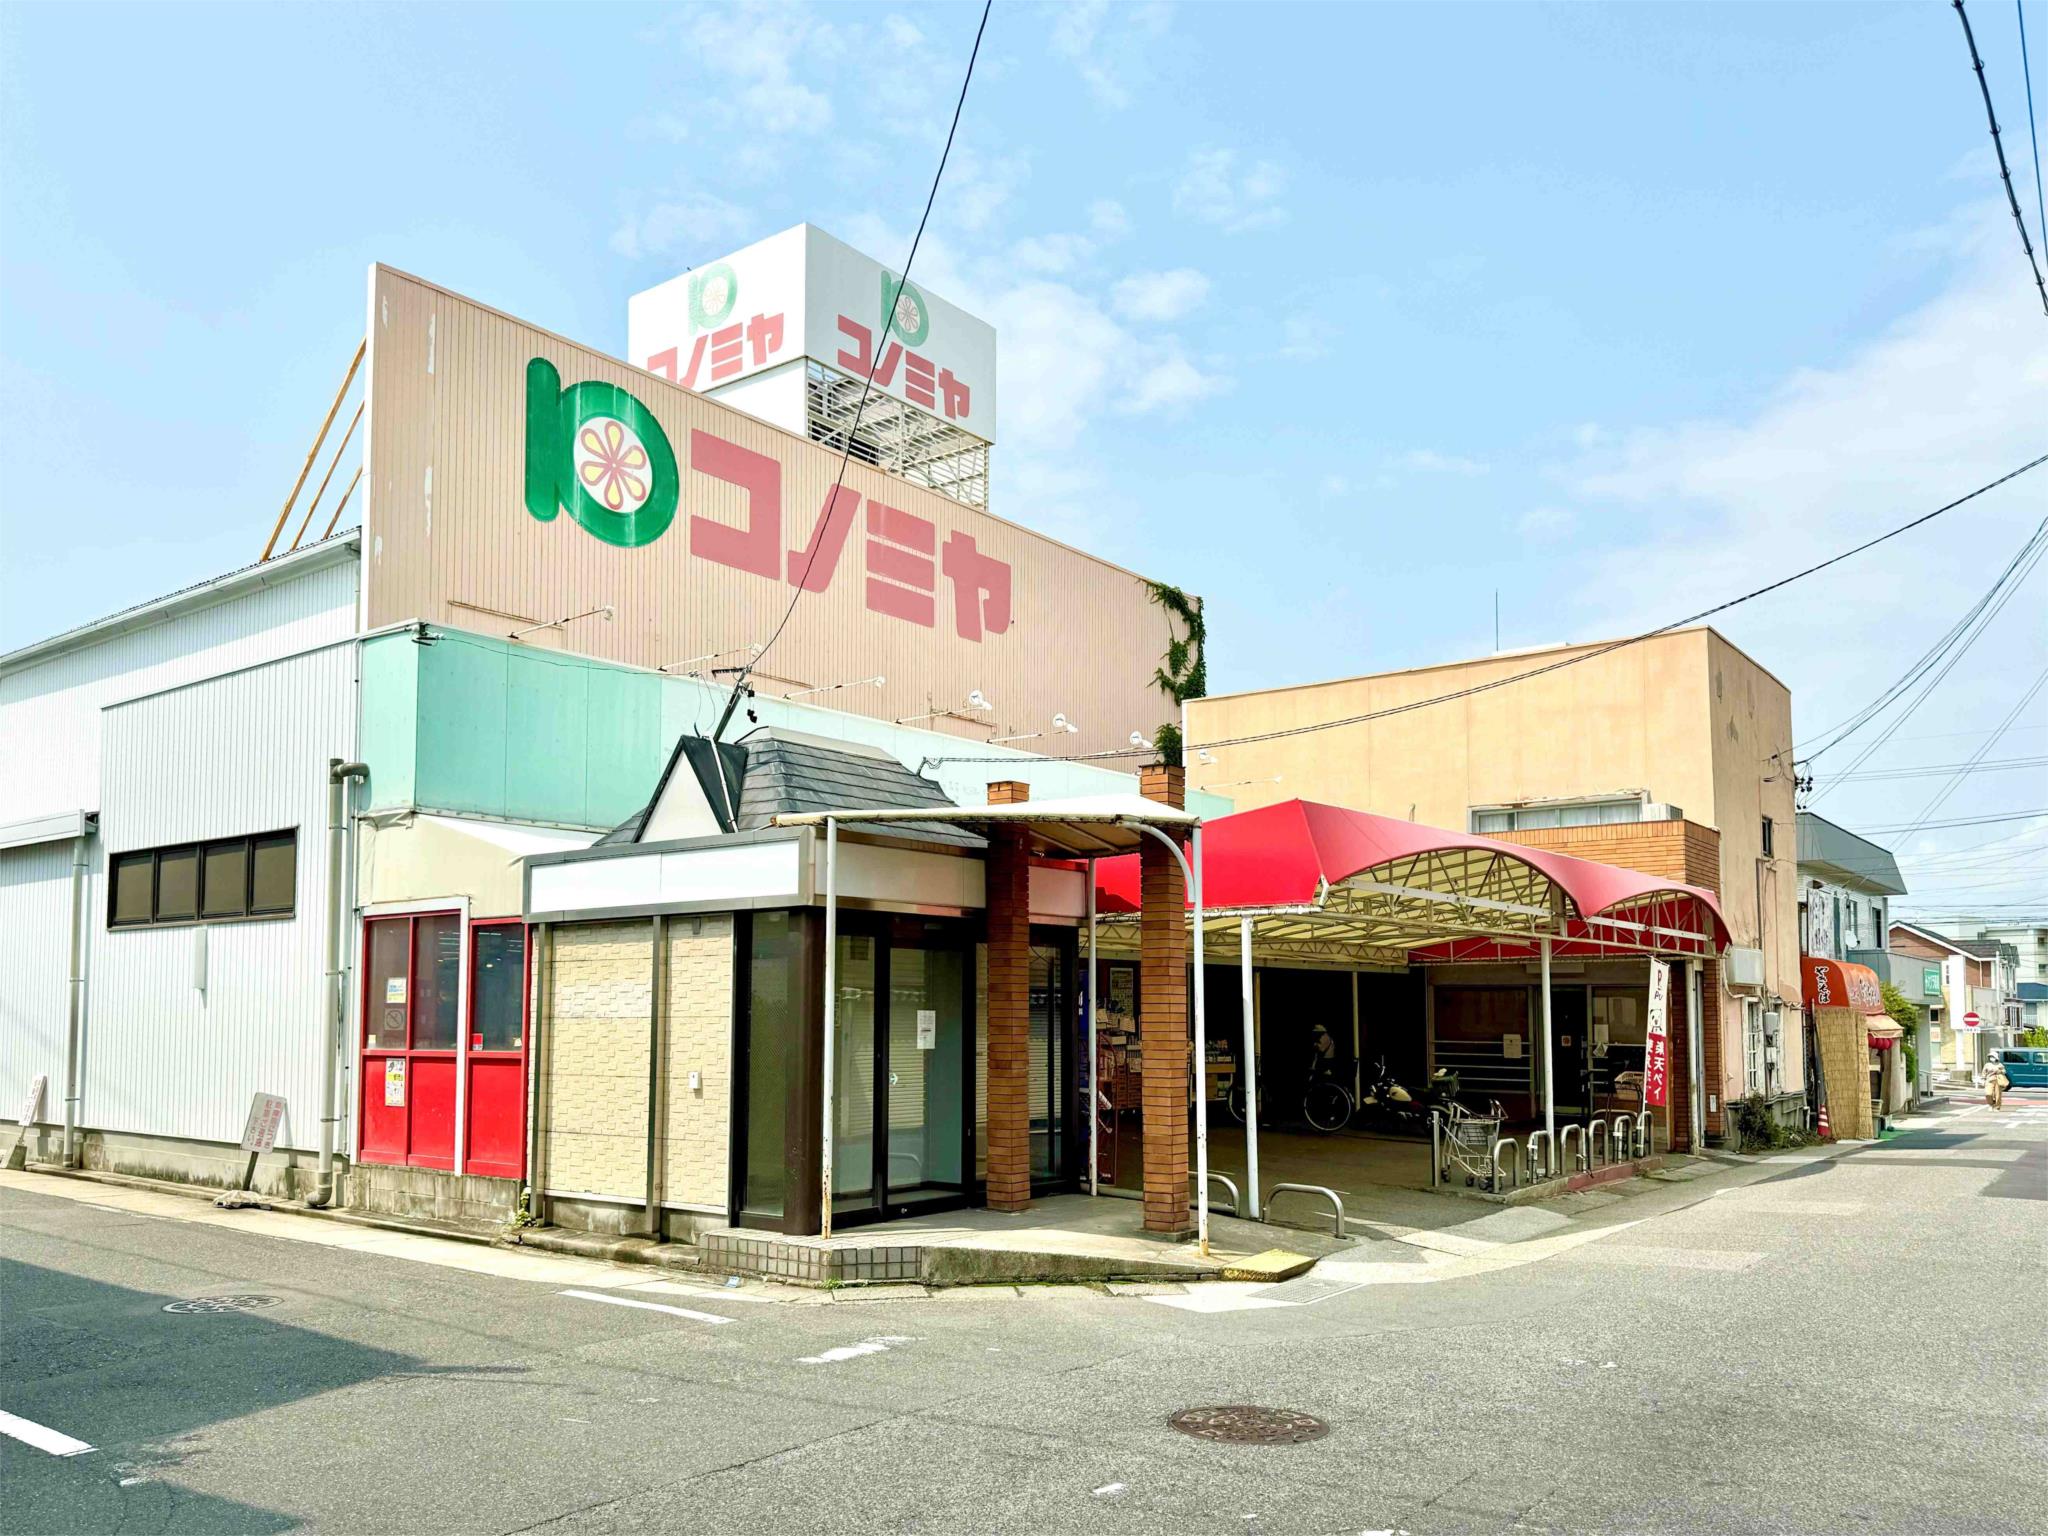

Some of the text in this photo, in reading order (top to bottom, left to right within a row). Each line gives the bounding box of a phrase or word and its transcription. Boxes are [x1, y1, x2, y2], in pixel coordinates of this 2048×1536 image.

[647, 312, 785, 389] コノミヤ
[837, 313, 971, 420] コノミヤ
[690, 427, 1012, 643] コノミヤ
[1653, 1040, 1665, 1101] 楽天ペイ
